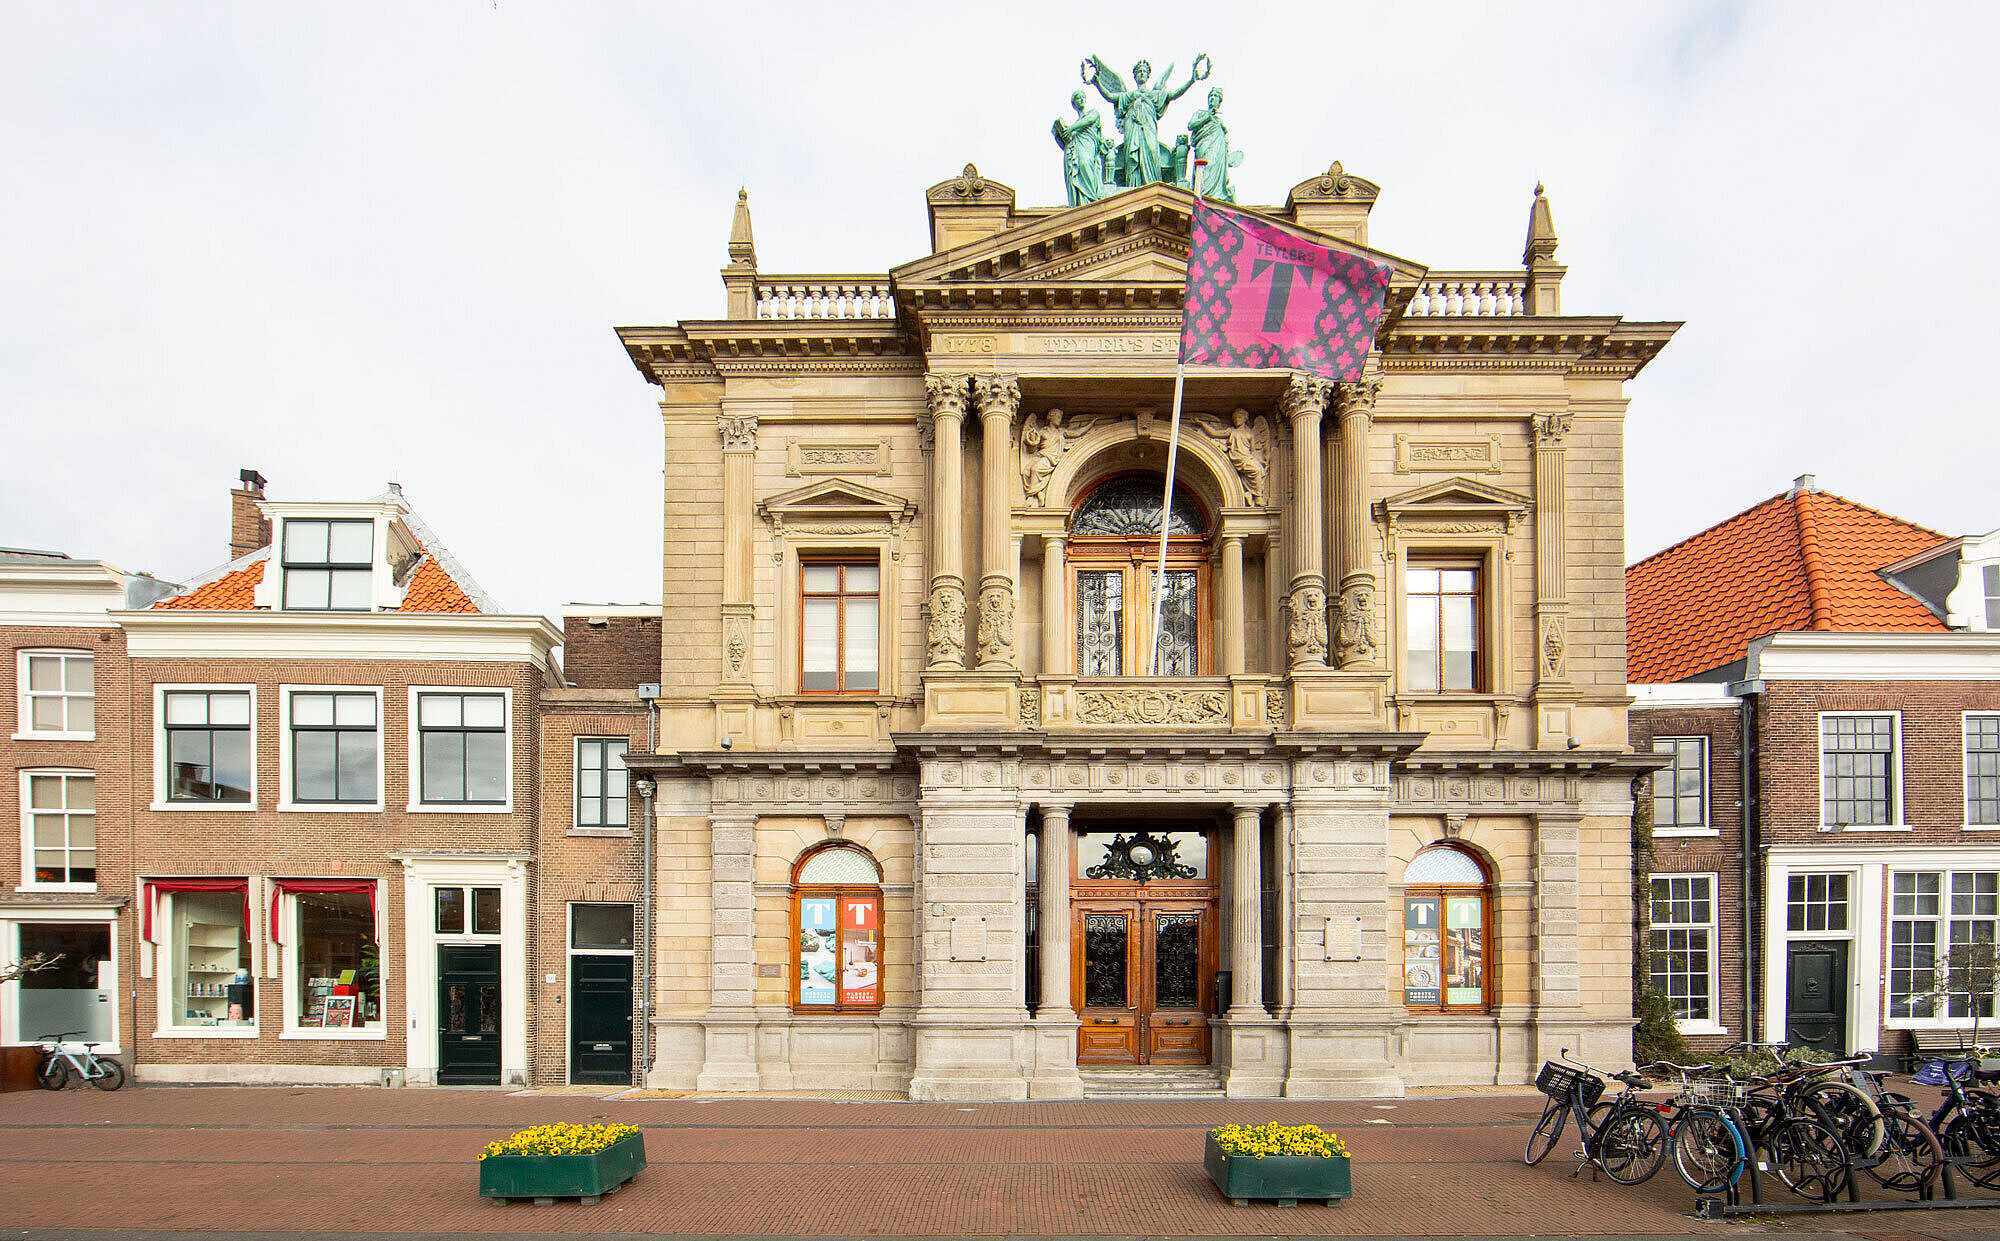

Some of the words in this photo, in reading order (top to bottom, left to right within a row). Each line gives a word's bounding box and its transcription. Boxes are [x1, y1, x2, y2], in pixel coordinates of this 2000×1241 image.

[1256, 242, 1316, 262] TEYLERS
[1250, 258, 1314, 333] T
[948, 337, 994, 353] 1778
[806, 903, 831, 925] T
[848, 903, 873, 925] T
[1410, 903, 1435, 925] T
